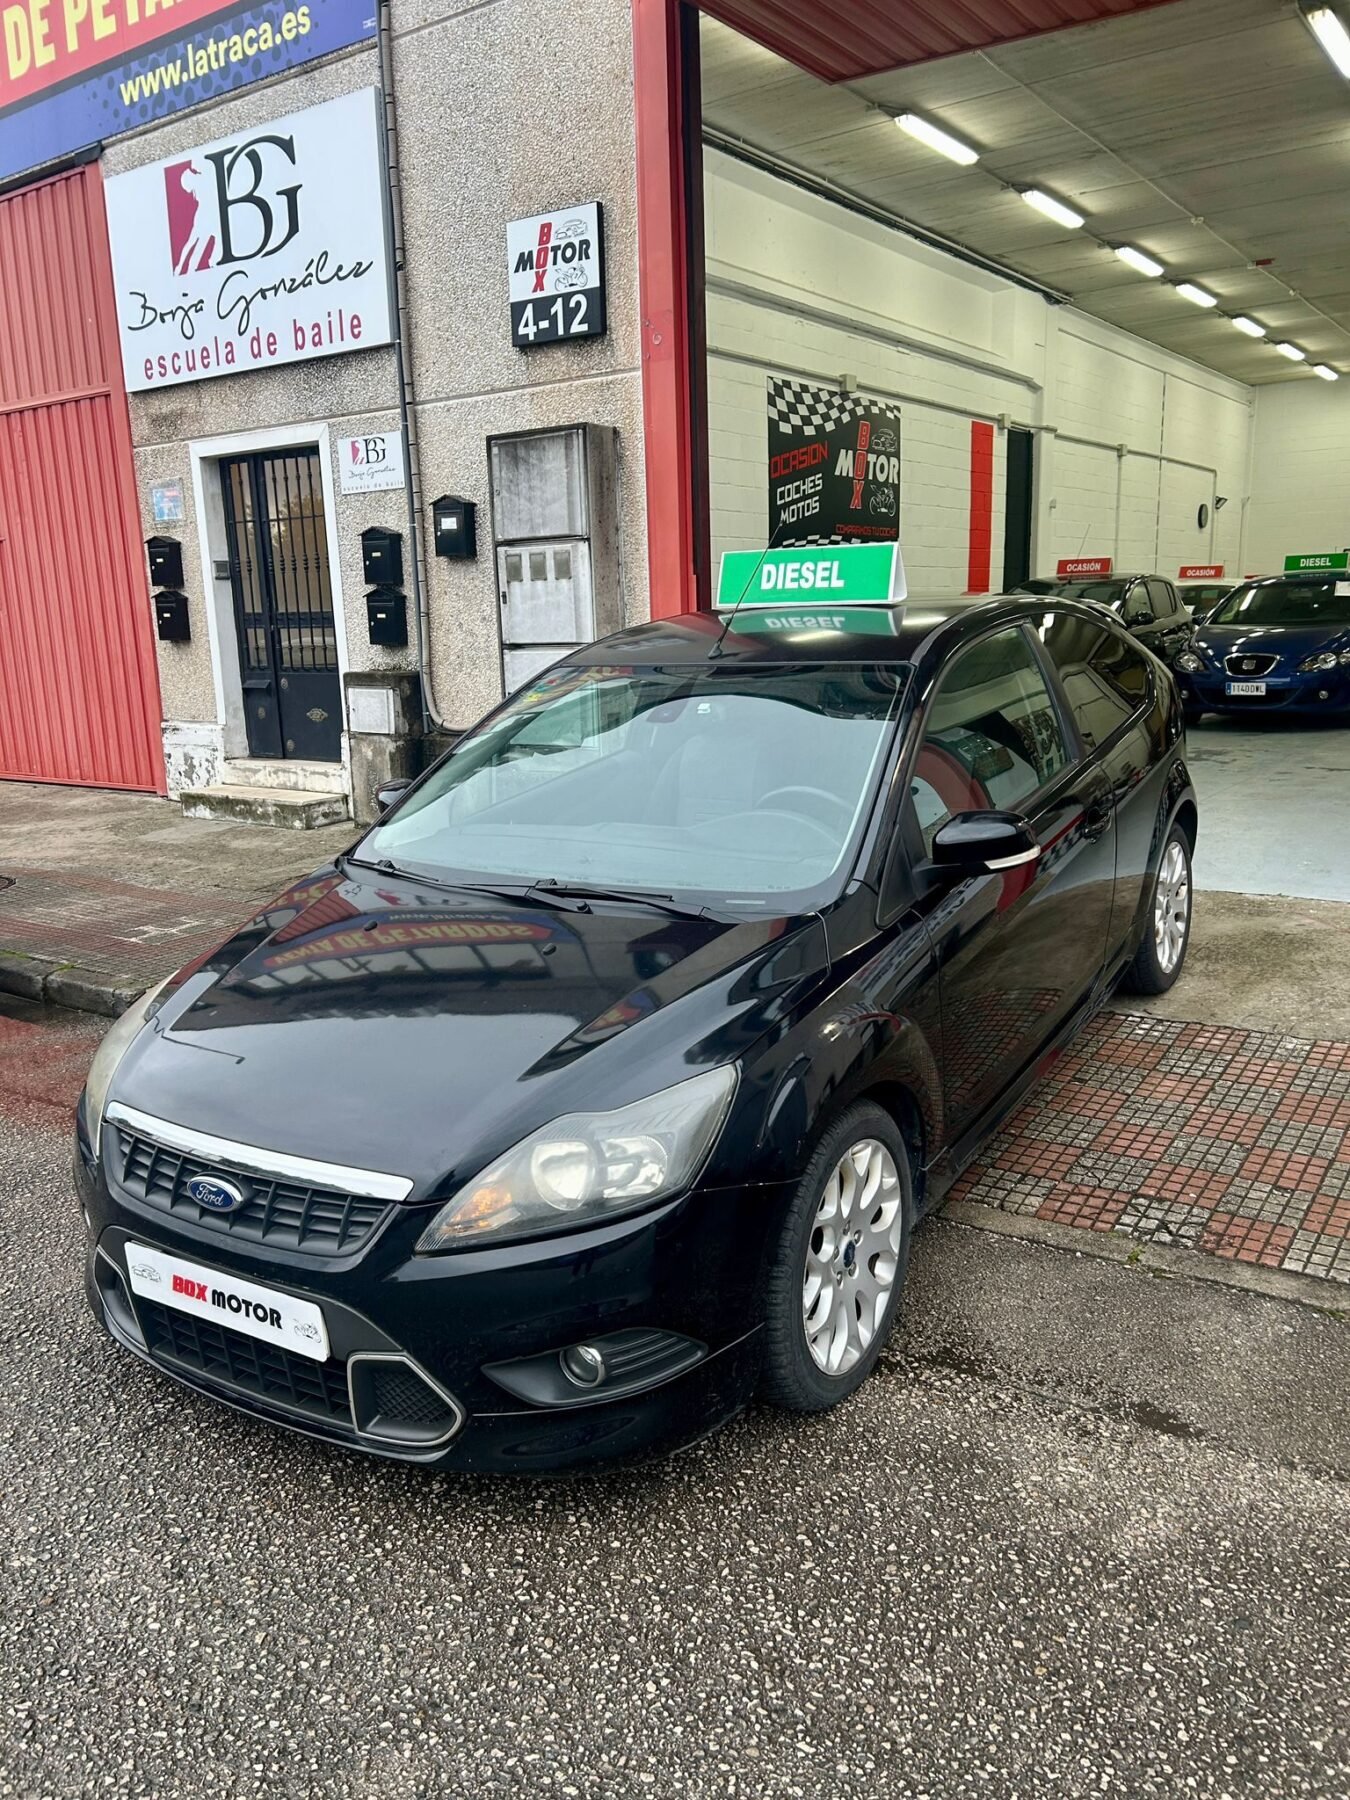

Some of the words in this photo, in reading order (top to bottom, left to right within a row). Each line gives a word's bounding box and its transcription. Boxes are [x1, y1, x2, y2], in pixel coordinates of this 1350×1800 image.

[3, 0, 56, 80] DE
[120, 5, 311, 105] www.latraca.es
[204, 134, 302, 266] BG
[514, 239, 591, 273] MOTOR
[532, 222, 552, 293] BOX
[128, 291, 204, 339] Borja
[217, 251, 374, 336] González
[518, 293, 589, 341] 4-12
[144, 336, 235, 380] escuela
[250, 327, 278, 359] de
[293, 309, 362, 350] baile
[835, 449, 899, 484] MOTOR
[850, 420, 871, 509] BOX
[776, 473, 823, 505] COCHES
[780, 496, 820, 524] MOTOS
[760, 561, 845, 590] DIESEL
[1066, 561, 1101, 572] OCASIÓN
[1186, 568, 1215, 577] OCASIÓN
[1300, 557, 1332, 567] DIESEL
[195, 1183, 225, 1207] Ford
[172, 1274, 208, 1302] BOX
[211, 1289, 283, 1330] MOTOR
